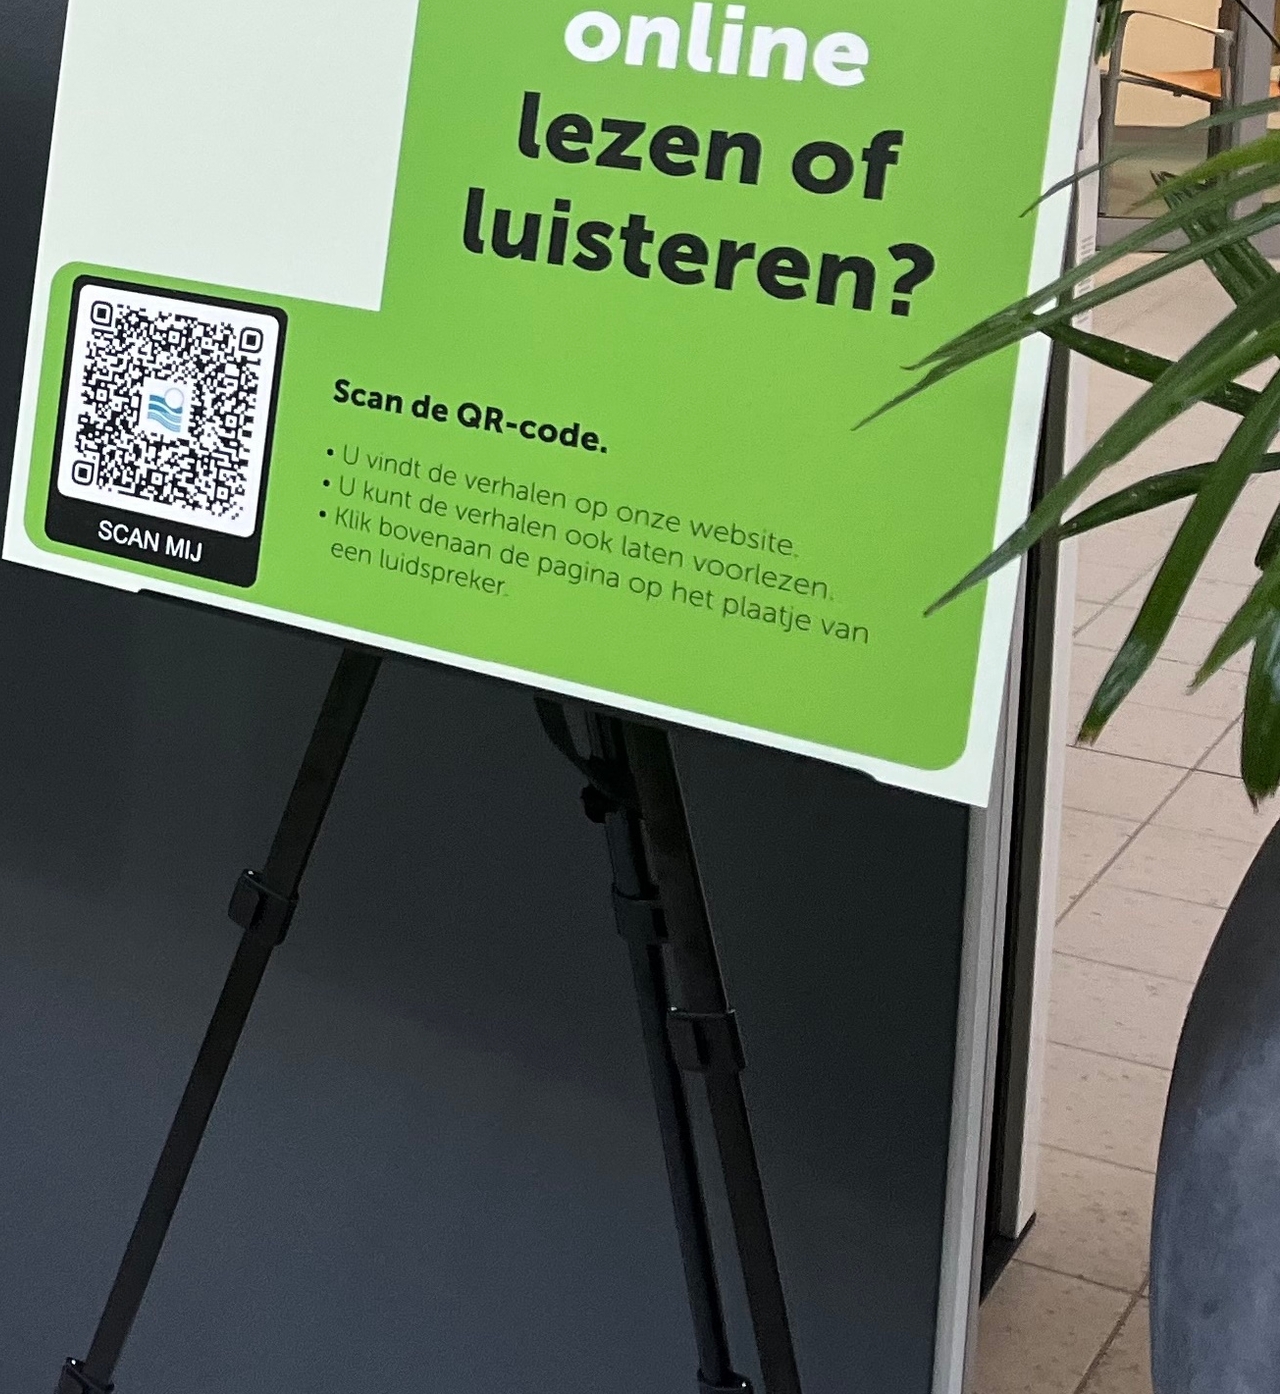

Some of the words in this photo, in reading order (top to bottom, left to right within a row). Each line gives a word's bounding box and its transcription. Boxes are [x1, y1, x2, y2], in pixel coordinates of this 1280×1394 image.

[564, 1, 870, 88] online
[518, 91, 762, 186] lezen
[792, 130, 904, 201] of
[463, 187, 935, 317] luisteren?
[333, 379, 403, 414] Scan
[411, 395, 449, 423] de
[457, 402, 608, 454] QR-code.
[98, 520, 160, 552] SCAN
[165, 535, 203, 563] MIJ
[339, 475, 356, 497] U
[363, 480, 413, 510] kunt
[419, 494, 448, 518] de
[456, 505, 557, 541] verhalen
[565, 529, 614, 554] ook
[622, 535, 684, 568] laten
[693, 555, 834, 601] voorlezen.
[343, 444, 360, 466] U
[367, 454, 421, 479] vindt
[428, 463, 457, 487] de
[465, 474, 566, 509] verhalen
[575, 497, 608, 522] op
[616, 506, 681, 533] onze
[690, 520, 799, 558] website.
[331, 543, 372, 565] een
[380, 548, 509, 597] luidspreker.
[335, 506, 372, 533] Klik
[379, 516, 492, 560] bovenaan
[500, 545, 530, 569] de
[537, 556, 620, 589] pagina
[629, 577, 663, 602] op
[672, 580, 715, 611] het
[722, 596, 812, 634] plaatje
[821, 619, 869, 645] van
